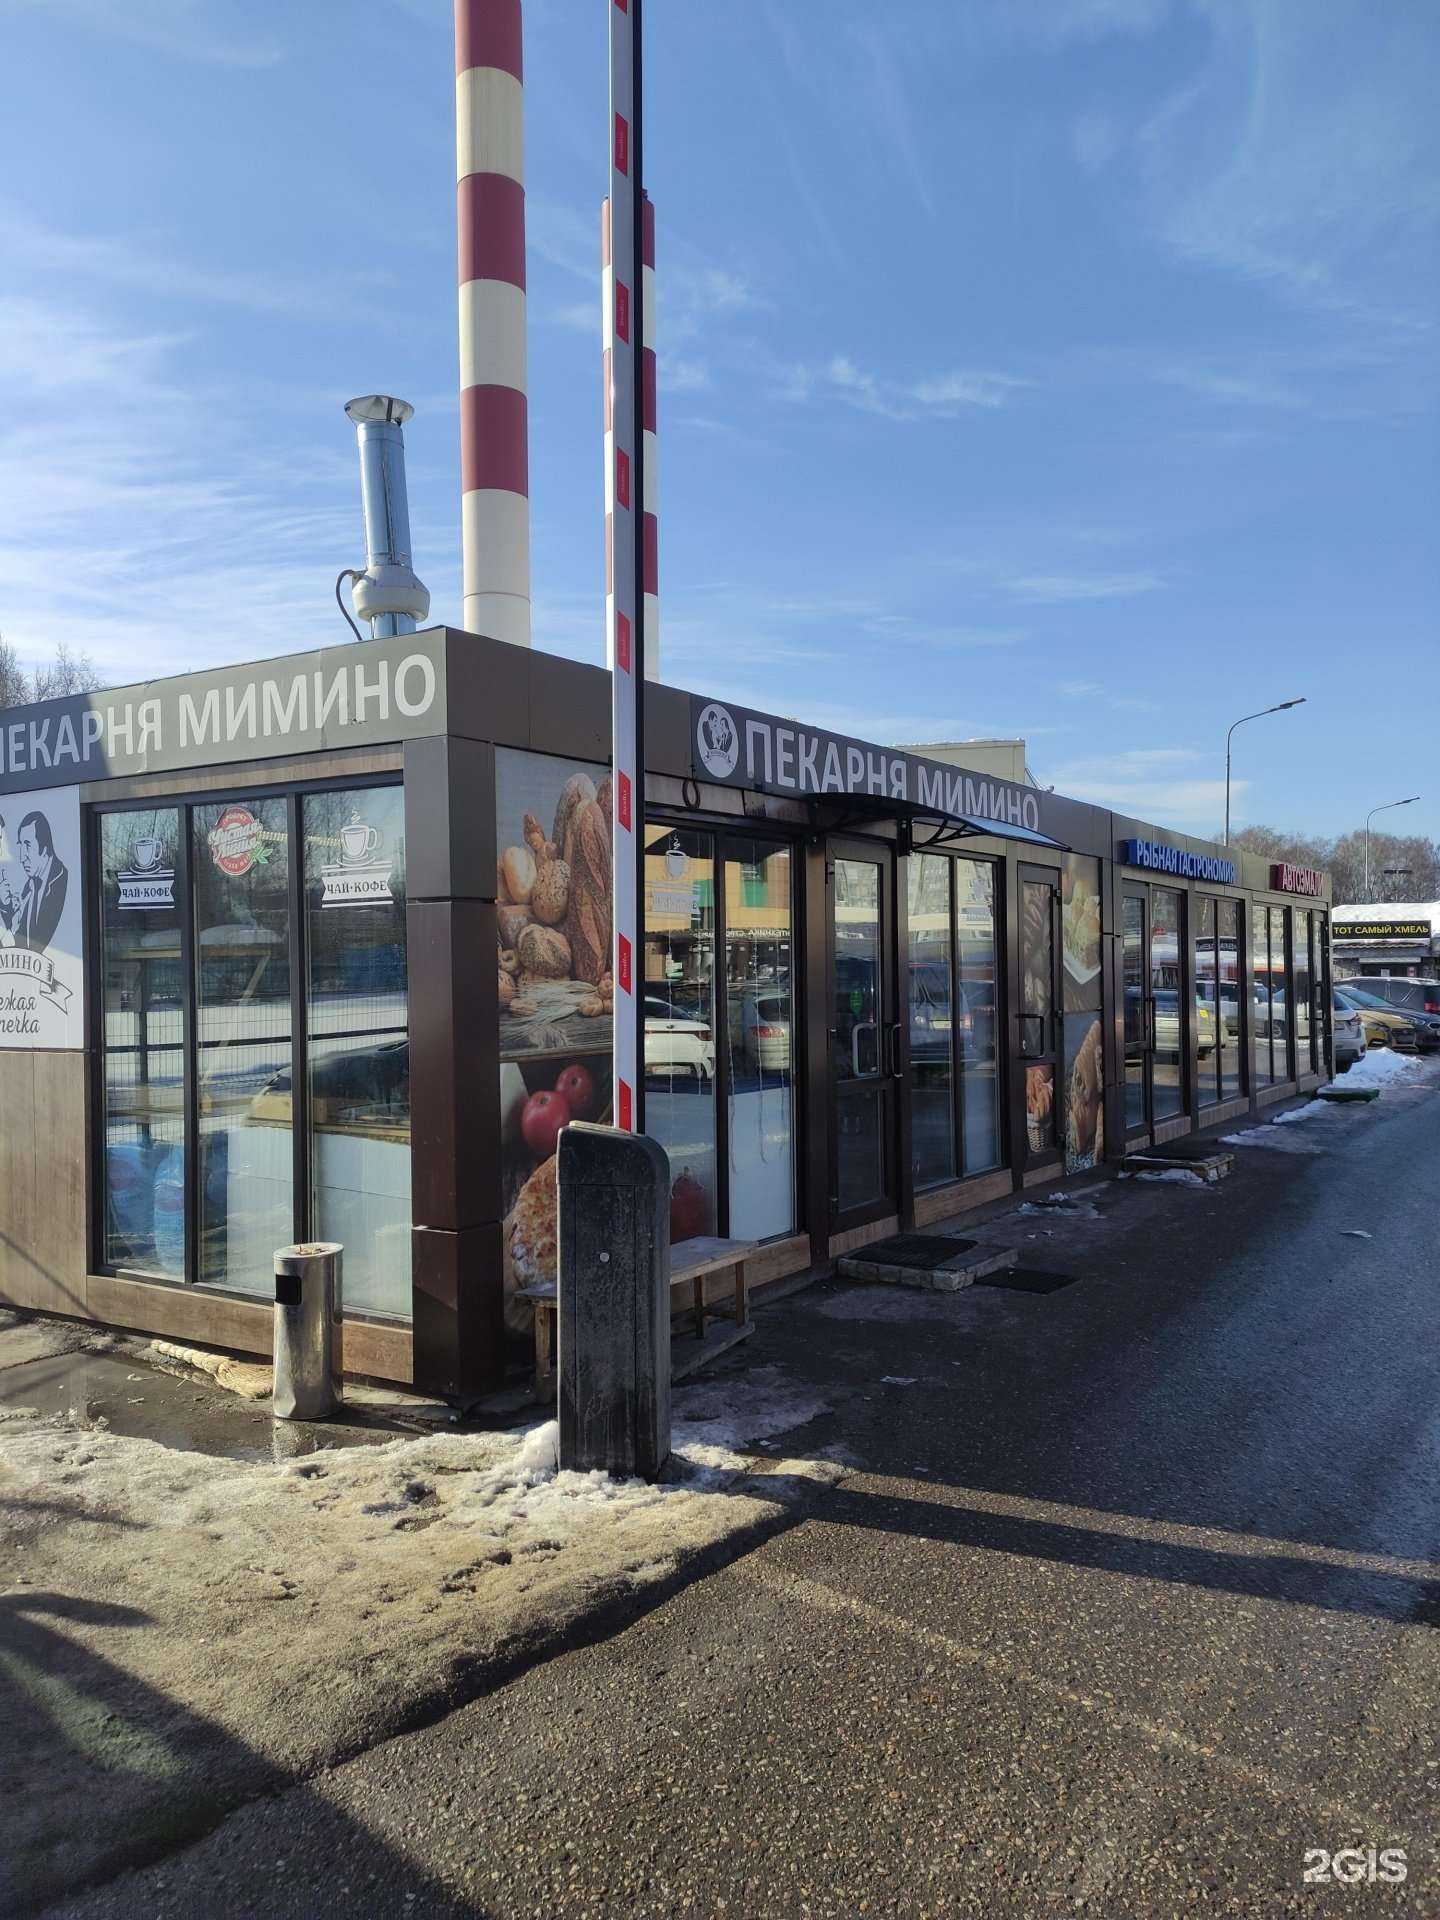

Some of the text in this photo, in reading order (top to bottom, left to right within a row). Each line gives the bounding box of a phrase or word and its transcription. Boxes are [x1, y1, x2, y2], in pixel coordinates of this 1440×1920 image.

[0, 653, 436, 775] ЕКАРНЯ МИМИНО
[745, 719, 1040, 832] ПЕКАРНЯ МИМИНО
[1136, 840, 1236, 884] РЫБНАЯ ГАСТРОНОМИЯ
[1282, 863, 1324, 897] АВТОЭМАЛИ
[1334, 924, 1429, 935] ТОТ САМЫЙ ХМЕЛЬ
